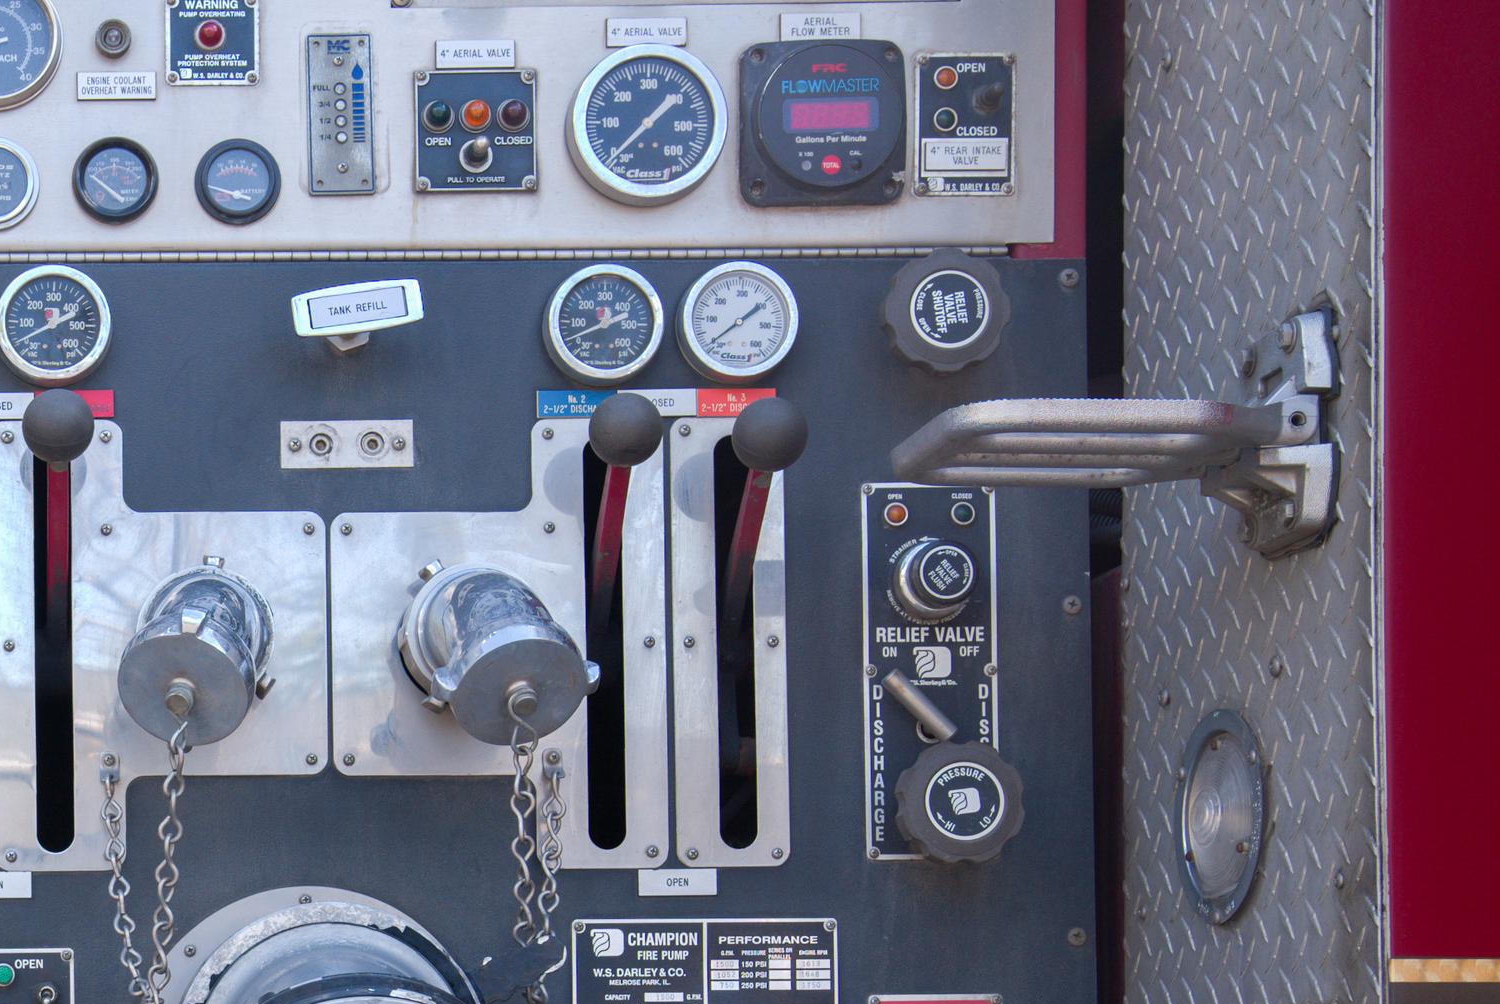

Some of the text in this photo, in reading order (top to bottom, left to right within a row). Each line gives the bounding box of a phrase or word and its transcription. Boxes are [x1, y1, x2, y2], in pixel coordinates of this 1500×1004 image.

[185, 0, 238, 9] WARNING
[804, 18, 837, 26] AERIAL
[624, 27, 653, 37] AERIAL
[658, 27, 682, 36] VALVE
[791, 27, 850, 36] FLOW METER
[454, 49, 482, 58] AERIAL
[487, 48, 510, 57] VALVE
[811, 64, 847, 72] FRC
[957, 63, 985, 72] OPEN
[87, 76, 145, 85] ENGINE COOLANT
[640, 80, 657, 89] 300
[82, 86, 152, 96] OVERHEAT WARNING
[782, 79, 879, 94] FLOWMASTER
[614, 92, 631, 101] 200
[602, 118, 619, 127] 100
[674, 122, 692, 131] 500
[957, 127, 997, 136] CLOSED
[425, 137, 451, 145] OPEN
[495, 136, 532, 145] CLOSED
[664, 146, 683, 155] 600
[945, 147, 968, 155] REAR
[973, 146, 1001, 154] INTAKE
[953, 157, 978, 165] VALVE
[960, 183, 982, 192] DARLEY
[598, 292, 613, 300] 300
[329, 302, 387, 315] TANK REFILL
[579, 301, 594, 309] 200
[615, 302, 630, 311] 400
[944, 294, 957, 324] VALVE
[955, 291, 968, 323] RELIEF
[932, 290, 947, 333] SHUTOFF
[571, 318, 586, 327] 100
[621, 321, 636, 329] 500
[615, 338, 630, 347] 600
[889, 539, 917, 563] STRAINER
[876, 626, 984, 642] RELIEF VALVE
[883, 647, 897, 657] ON
[959, 646, 979, 656] OFF
[873, 684, 885, 841] DISCHARGE
[938, 768, 985, 786] PRESSURE
[667, 878, 689, 886] OPEN
[628, 932, 698, 946] CHAMPION
[719, 936, 818, 944] PERFORMANCE
[638, 951, 688, 960] FIRE PUMP
[15, 959, 43, 969] OPEN
[593, 968, 686, 977] W.S. DARLEY CO.
